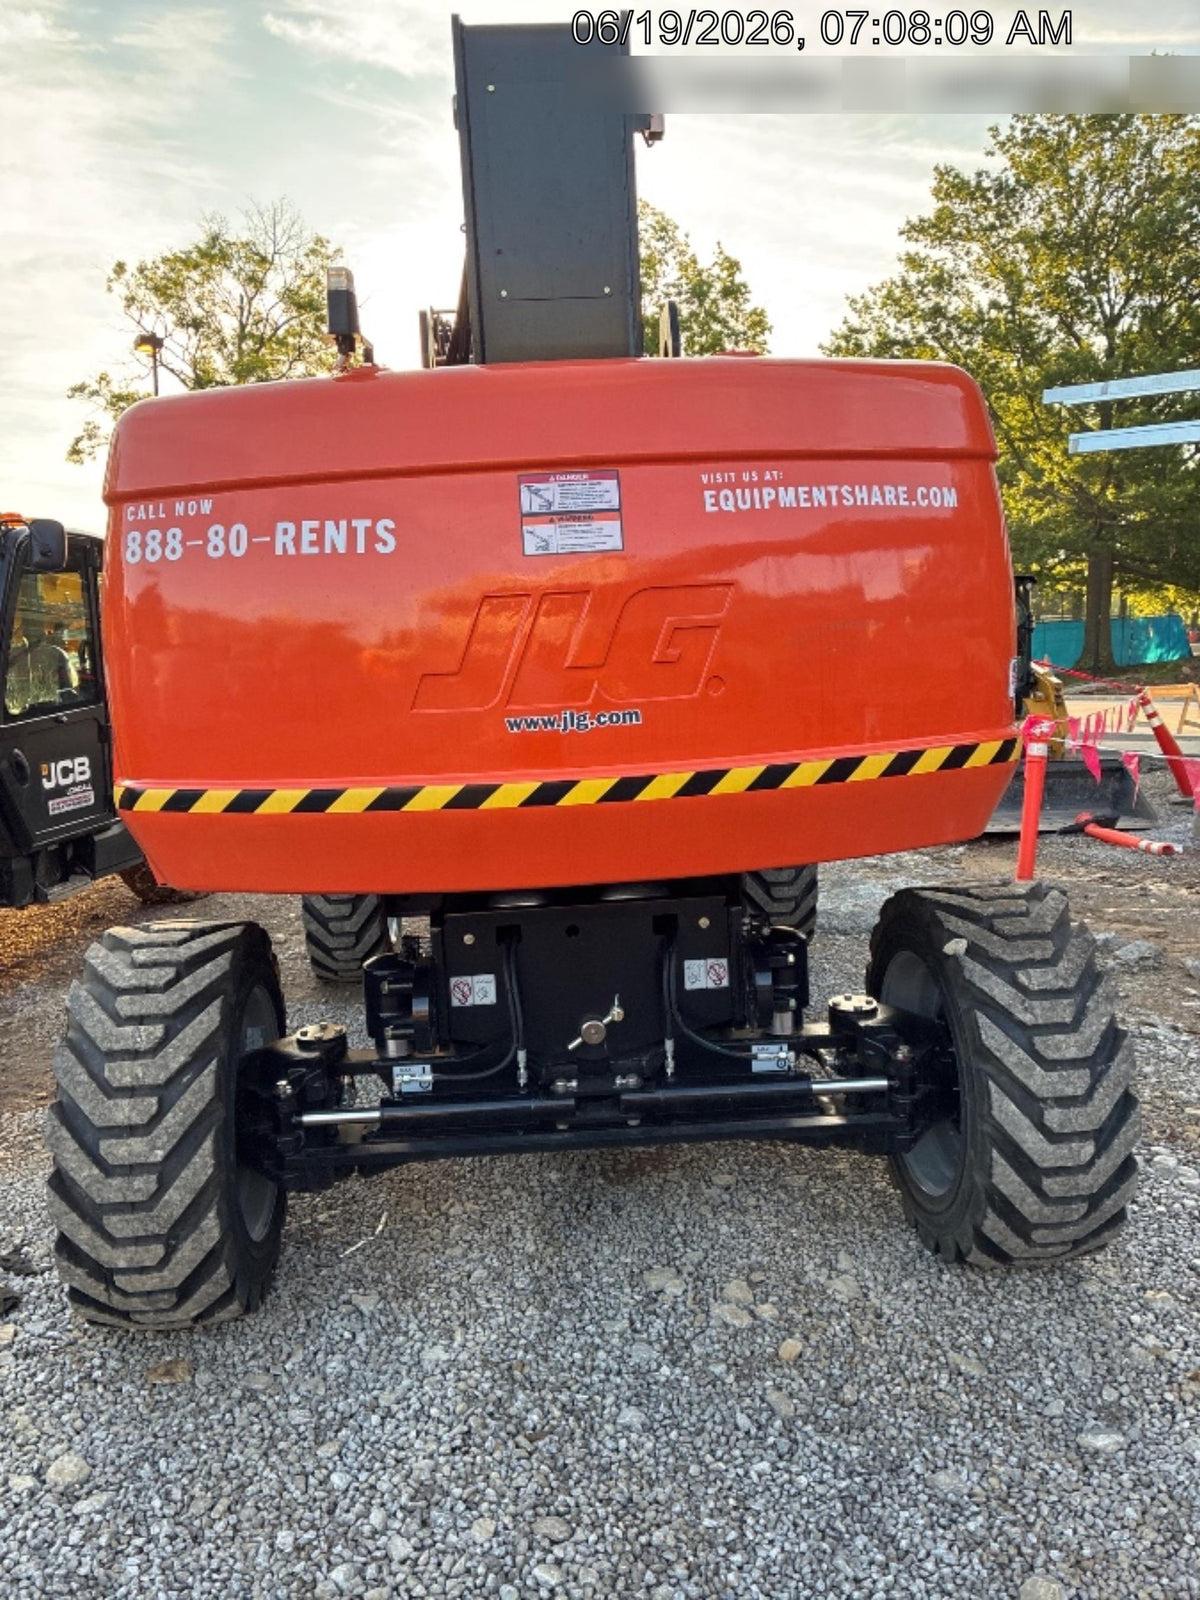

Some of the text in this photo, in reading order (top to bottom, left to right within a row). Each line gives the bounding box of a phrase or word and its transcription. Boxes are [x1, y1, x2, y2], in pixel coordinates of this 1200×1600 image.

[701, 470, 784, 485] VISIT US AT:
[126, 498, 213, 522] CALL NOW
[703, 484, 958, 513] EQUIPMENTSHARE.COM
[125, 518, 397, 564] 888-80-RENTS
[504, 708, 642, 733] www.jlg.com
[41, 756, 91, 790] JCB
